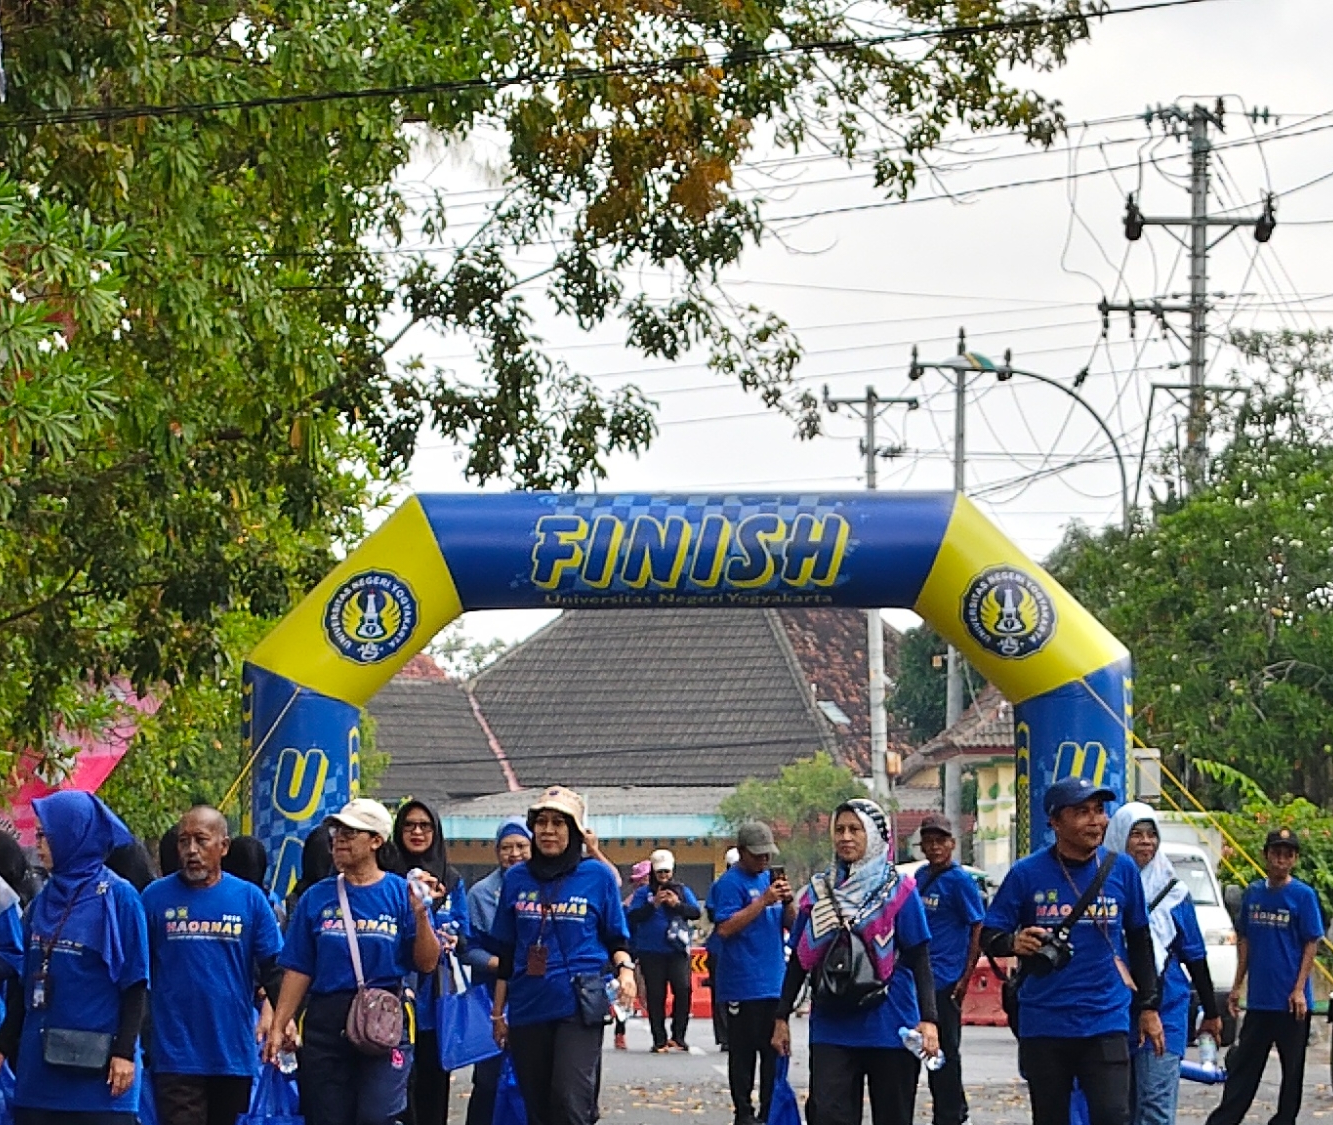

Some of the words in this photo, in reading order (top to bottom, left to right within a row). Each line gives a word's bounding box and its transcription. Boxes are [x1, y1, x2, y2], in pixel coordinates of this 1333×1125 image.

[531, 513, 850, 590] FINISH
[544, 593, 652, 605] Universitas
[658, 593, 724, 605] Negeri
[726, 592, 833, 606] Yogyakarta
[166, 920, 243, 936] HAORNAS
